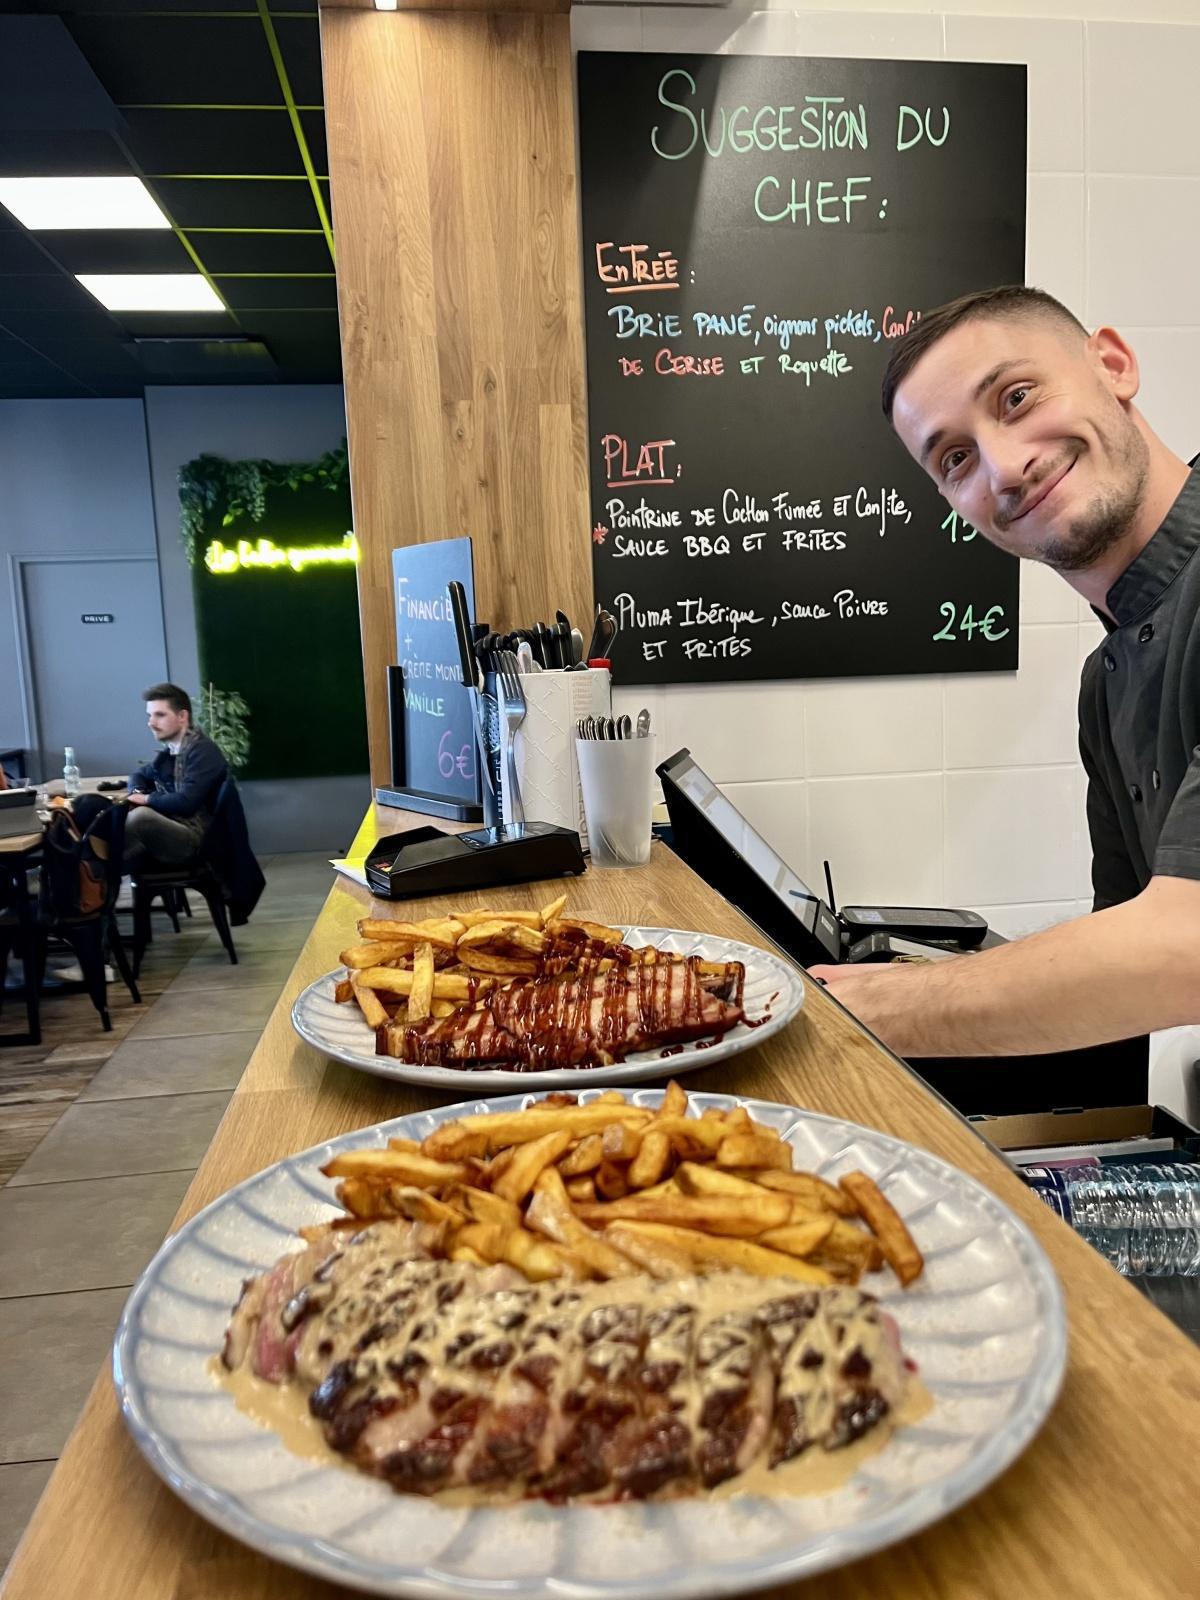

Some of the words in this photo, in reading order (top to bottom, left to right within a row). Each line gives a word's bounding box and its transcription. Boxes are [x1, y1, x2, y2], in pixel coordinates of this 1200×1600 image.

[651, 69, 868, 160] SUGGESTION
[897, 105, 950, 152] DU
[618, 356, 644, 376] DE
[655, 347, 725, 376] CERISE
[739, 356, 766, 375] ET
[778, 349, 854, 387] Roquette
[690, 508, 716, 527] DE
[833, 494, 852, 517] ET
[611, 534, 670, 558] SAUCE
[682, 534, 731, 558] BBQ
[742, 532, 767, 553] ET
[782, 528, 848, 552] FRITES
[932, 601, 1011, 643] 24€
[642, 640, 668, 661] ET
[681, 636, 753, 660] FRITES
[435, 663, 463, 682] MONT
[402, 687, 446, 717] VANILLE
[437, 730, 474, 780] 6€
